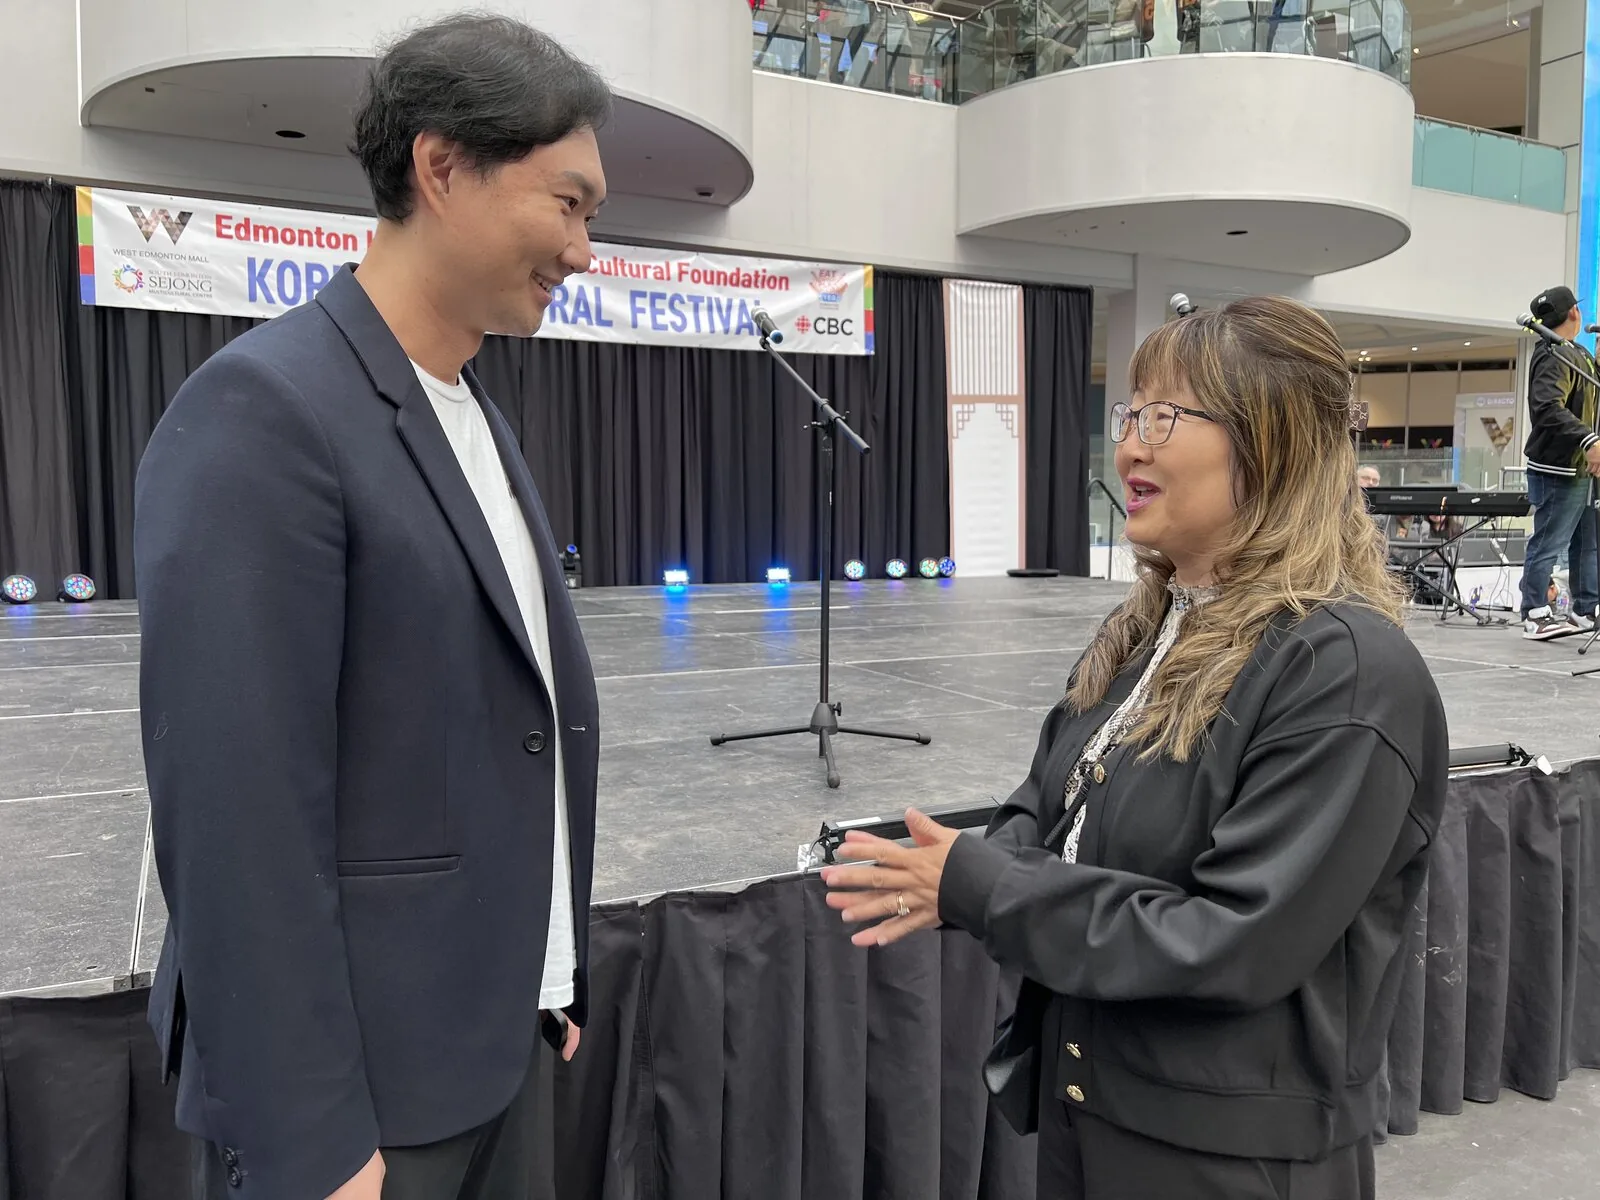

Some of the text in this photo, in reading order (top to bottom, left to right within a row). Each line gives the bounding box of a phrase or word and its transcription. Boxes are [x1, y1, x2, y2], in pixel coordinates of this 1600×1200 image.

[215, 213, 358, 252] Edmonton
[112, 248, 209, 263] WEST EDMONTON MALL
[148, 275, 212, 292] SEJONG
[677, 262, 790, 291] Foundation
[813, 316, 854, 336] CBC
